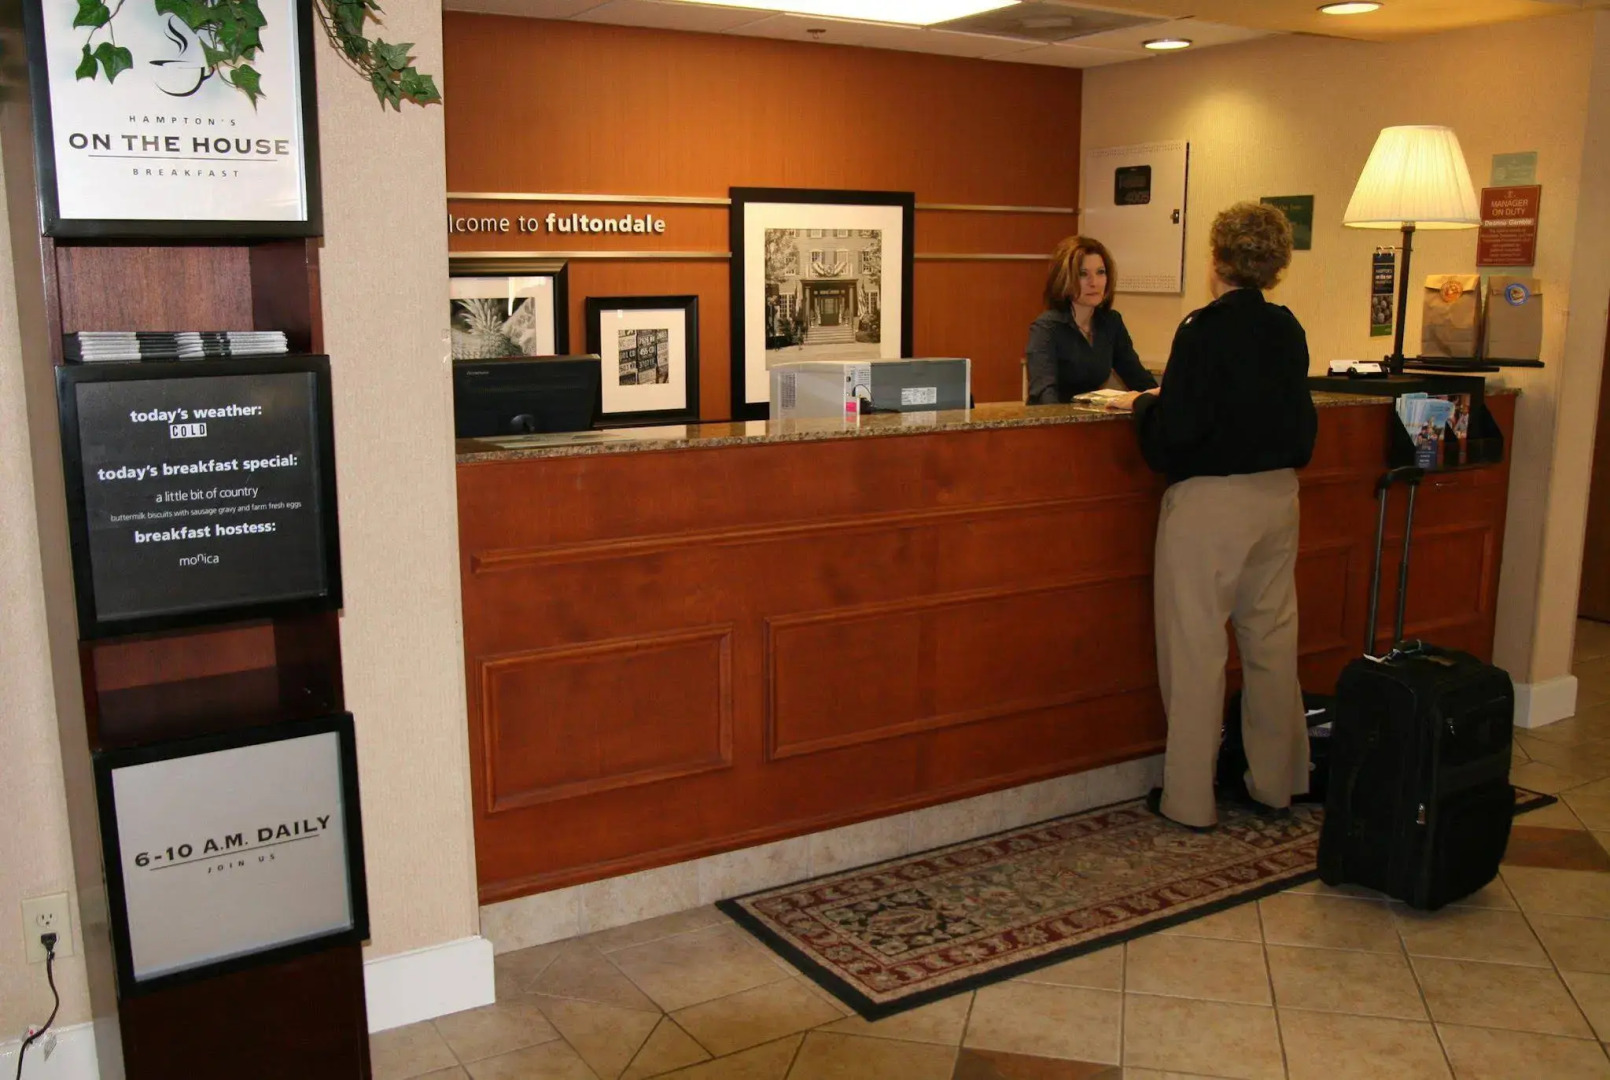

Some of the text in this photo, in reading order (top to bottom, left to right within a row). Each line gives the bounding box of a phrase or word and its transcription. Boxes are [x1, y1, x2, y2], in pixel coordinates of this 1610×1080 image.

[129, 114, 237, 126] HAMPTON'S
[68, 132, 290, 155] ON THE HOUSE
[133, 168, 239, 178] BREAKFAST
[1491, 199, 1528, 207] MANAGER
[519, 215, 538, 232] to
[546, 213, 666, 233] fultondale
[130, 404, 262, 423] today's weather:
[172, 424, 205, 437] COLD
[98, 454, 298, 482] today's breakfast special:
[156, 486, 258, 502] a little bit of country
[110, 511, 146, 522] buttermilk
[148, 510, 172, 519] biscuits
[174, 508, 190, 517] with
[190, 507, 216, 516] sausage
[218, 506, 236, 515] gravy
[238, 504, 250, 512] and
[286, 500, 302, 510] eggs
[134, 522, 276, 543] breakfast hostess:
[180, 552, 219, 566] monica
[135, 816, 331, 867] 6-10 A.M. DAILY
[207, 854, 276, 873] JOIN US
